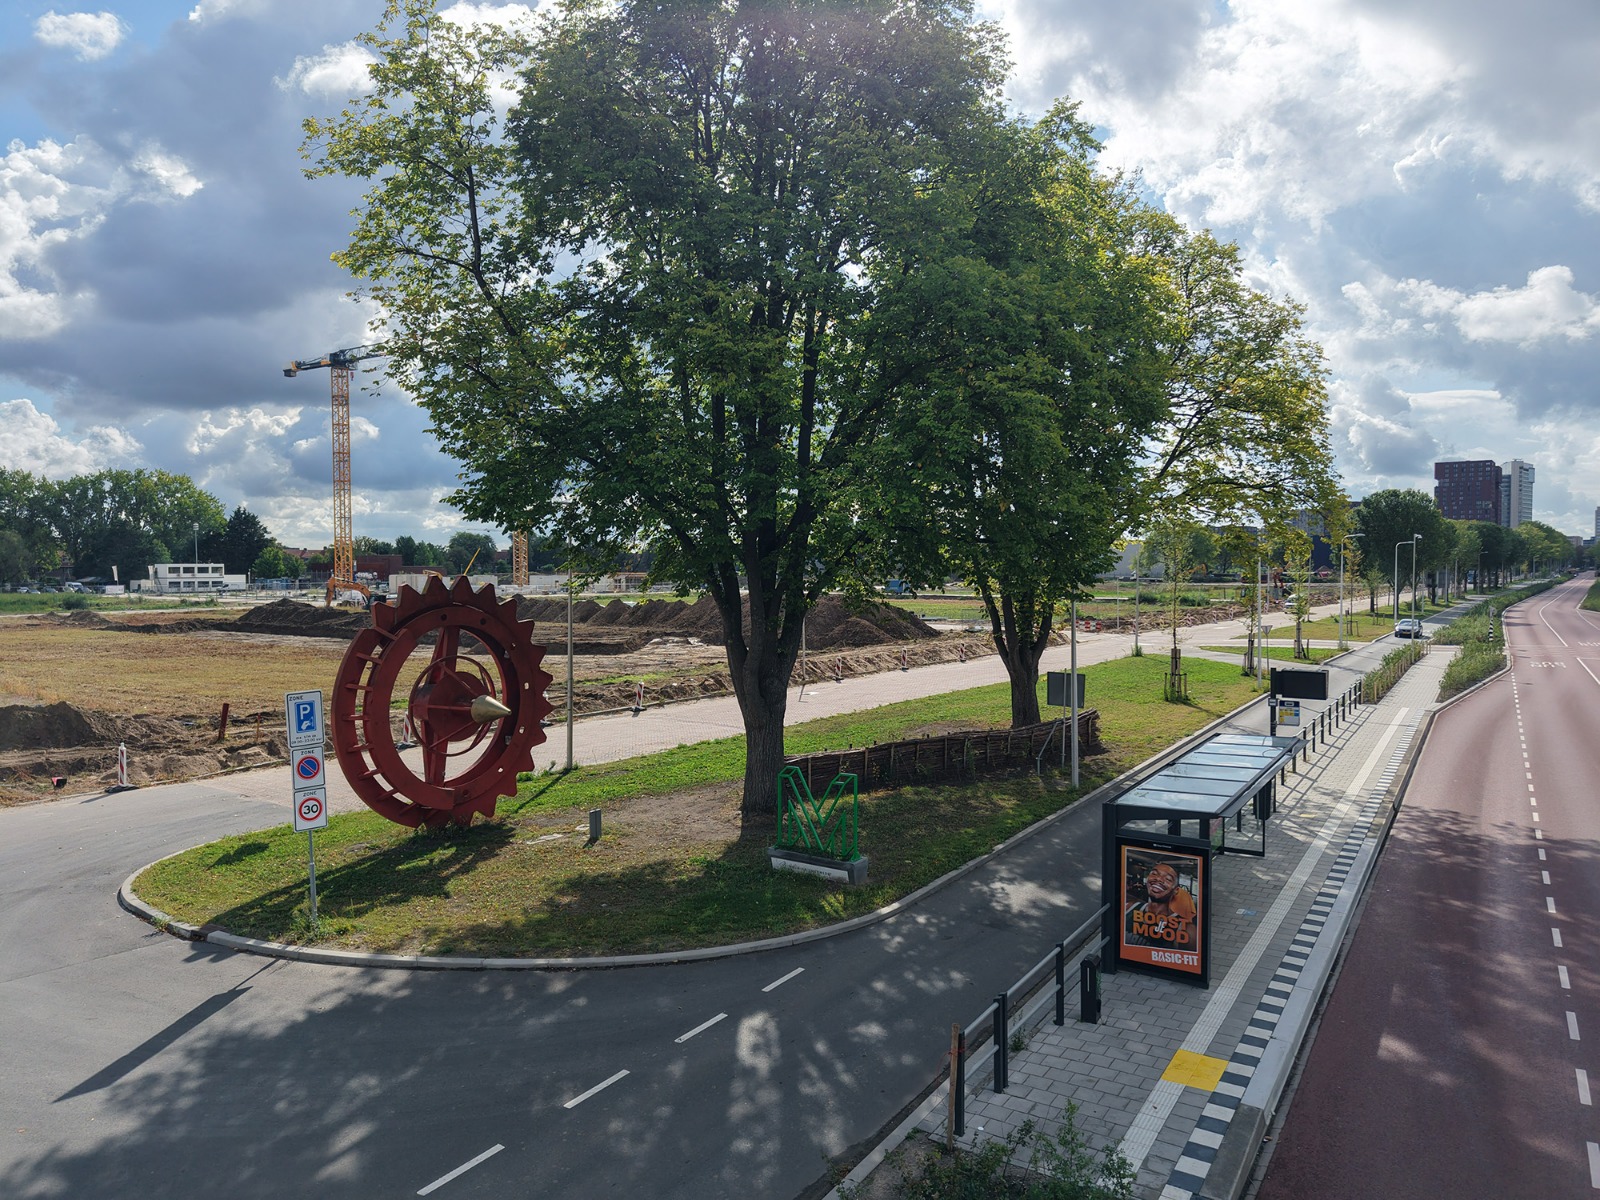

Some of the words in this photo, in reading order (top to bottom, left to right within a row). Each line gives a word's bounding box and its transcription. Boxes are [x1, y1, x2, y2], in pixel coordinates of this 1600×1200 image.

[300, 704, 310, 720] P
[303, 804, 319, 815] 30
[1133, 909, 1192, 931] BOOST
[1154, 920, 1167, 933] JE
[1132, 922, 1189, 944] MOOD
